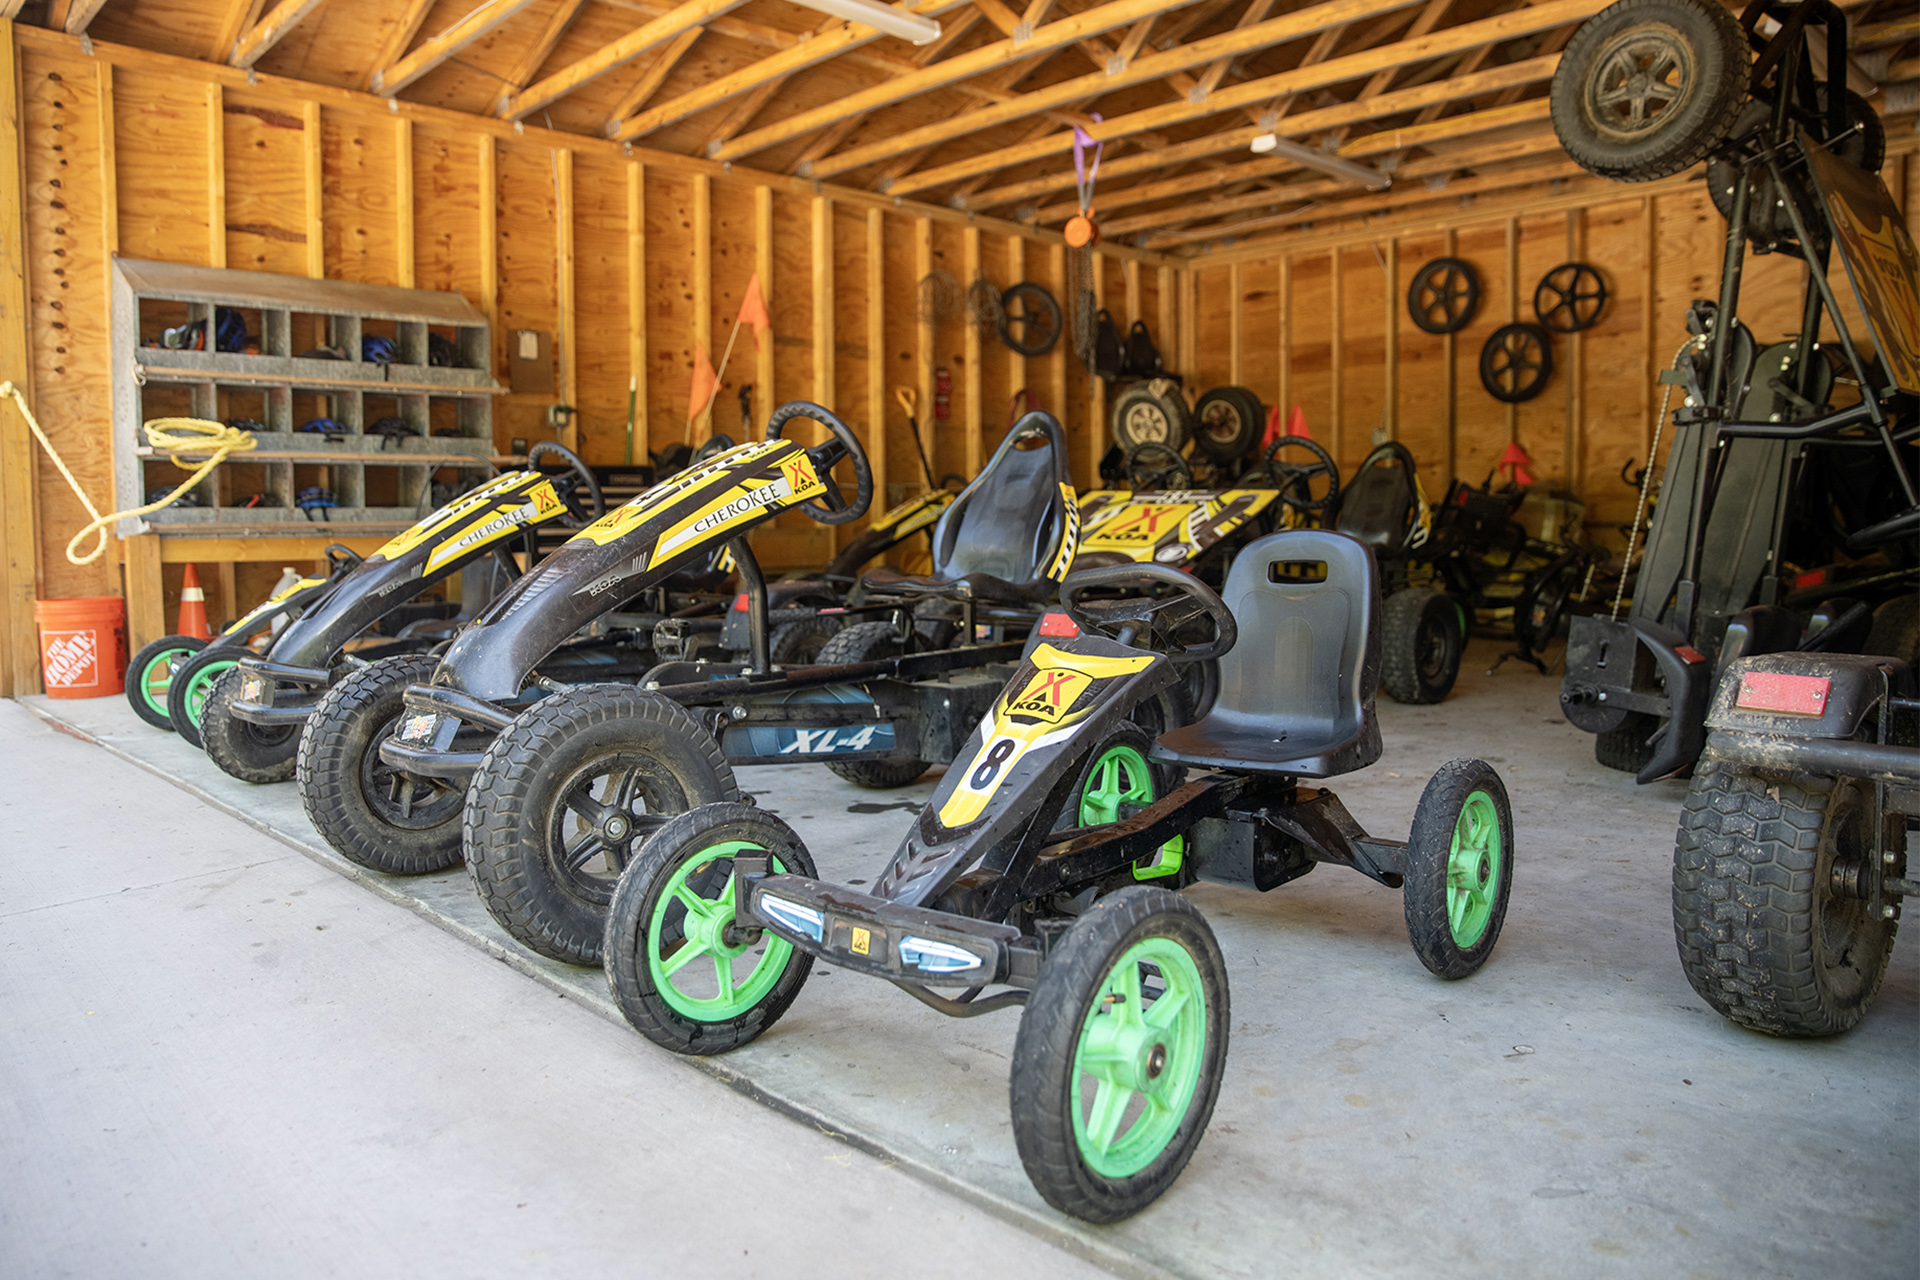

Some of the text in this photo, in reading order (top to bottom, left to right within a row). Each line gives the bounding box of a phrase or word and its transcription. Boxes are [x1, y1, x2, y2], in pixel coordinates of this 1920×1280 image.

[794, 481, 816, 494] KOA
[540, 503, 558, 515] KOA
[694, 483, 782, 533] CHEROKEE
[459, 506, 530, 547] CHEROKEE
[1096, 532, 1149, 541] KOA
[45, 631, 96, 686] HOME
[46, 636, 67, 659] THE
[60, 650, 96, 687] DEPOT
[1012, 701, 1055, 716] KOA
[779, 724, 877, 754] XL-4
[970, 739, 1016, 790] 8
